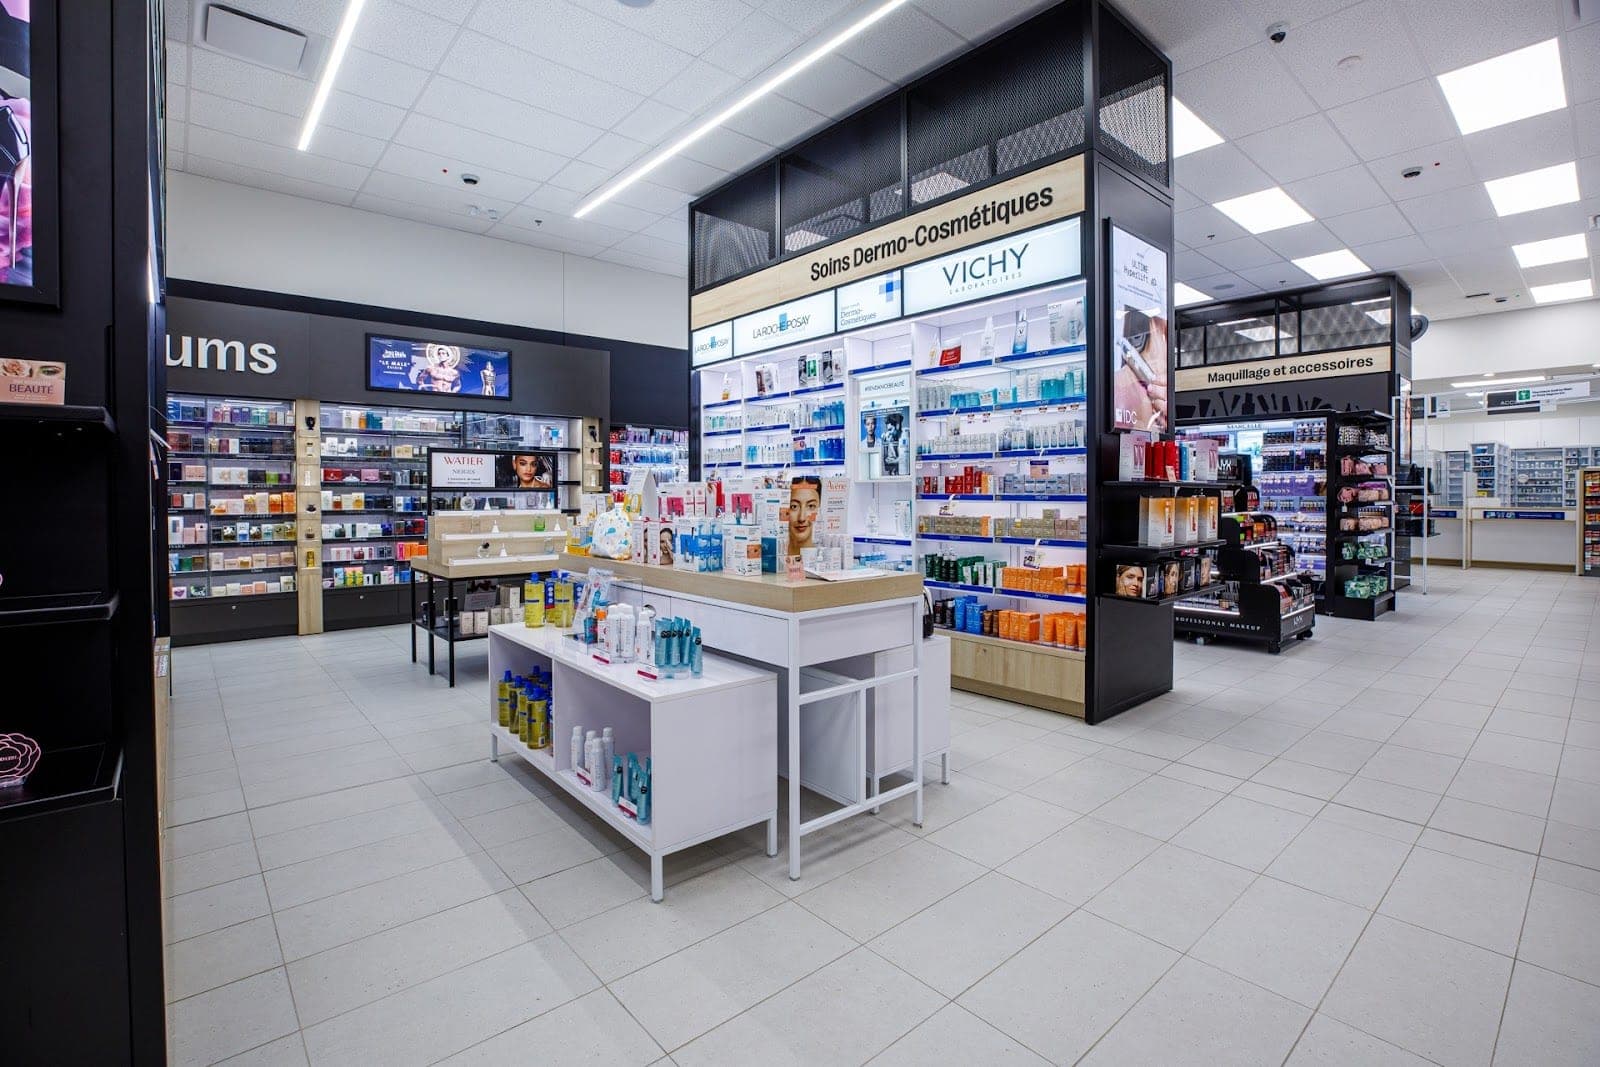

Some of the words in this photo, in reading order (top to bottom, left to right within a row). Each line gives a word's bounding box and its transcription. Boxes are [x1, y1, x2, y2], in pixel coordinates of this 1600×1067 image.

[810, 254, 850, 282] Soins
[853, 186, 1054, 268] Dermo-Cosmétiques
[942, 242, 1029, 287] VICHY
[949, 272, 1022, 295] LABORATOIRES
[165, 334, 277, 374] ums
[1207, 367, 1271, 384] Maquillage
[1273, 364, 1287, 376] et
[1289, 356, 1374, 375] accessoires
[443, 456, 484, 465] WATIER
[1229, 623, 1261, 631] MAKEUP
